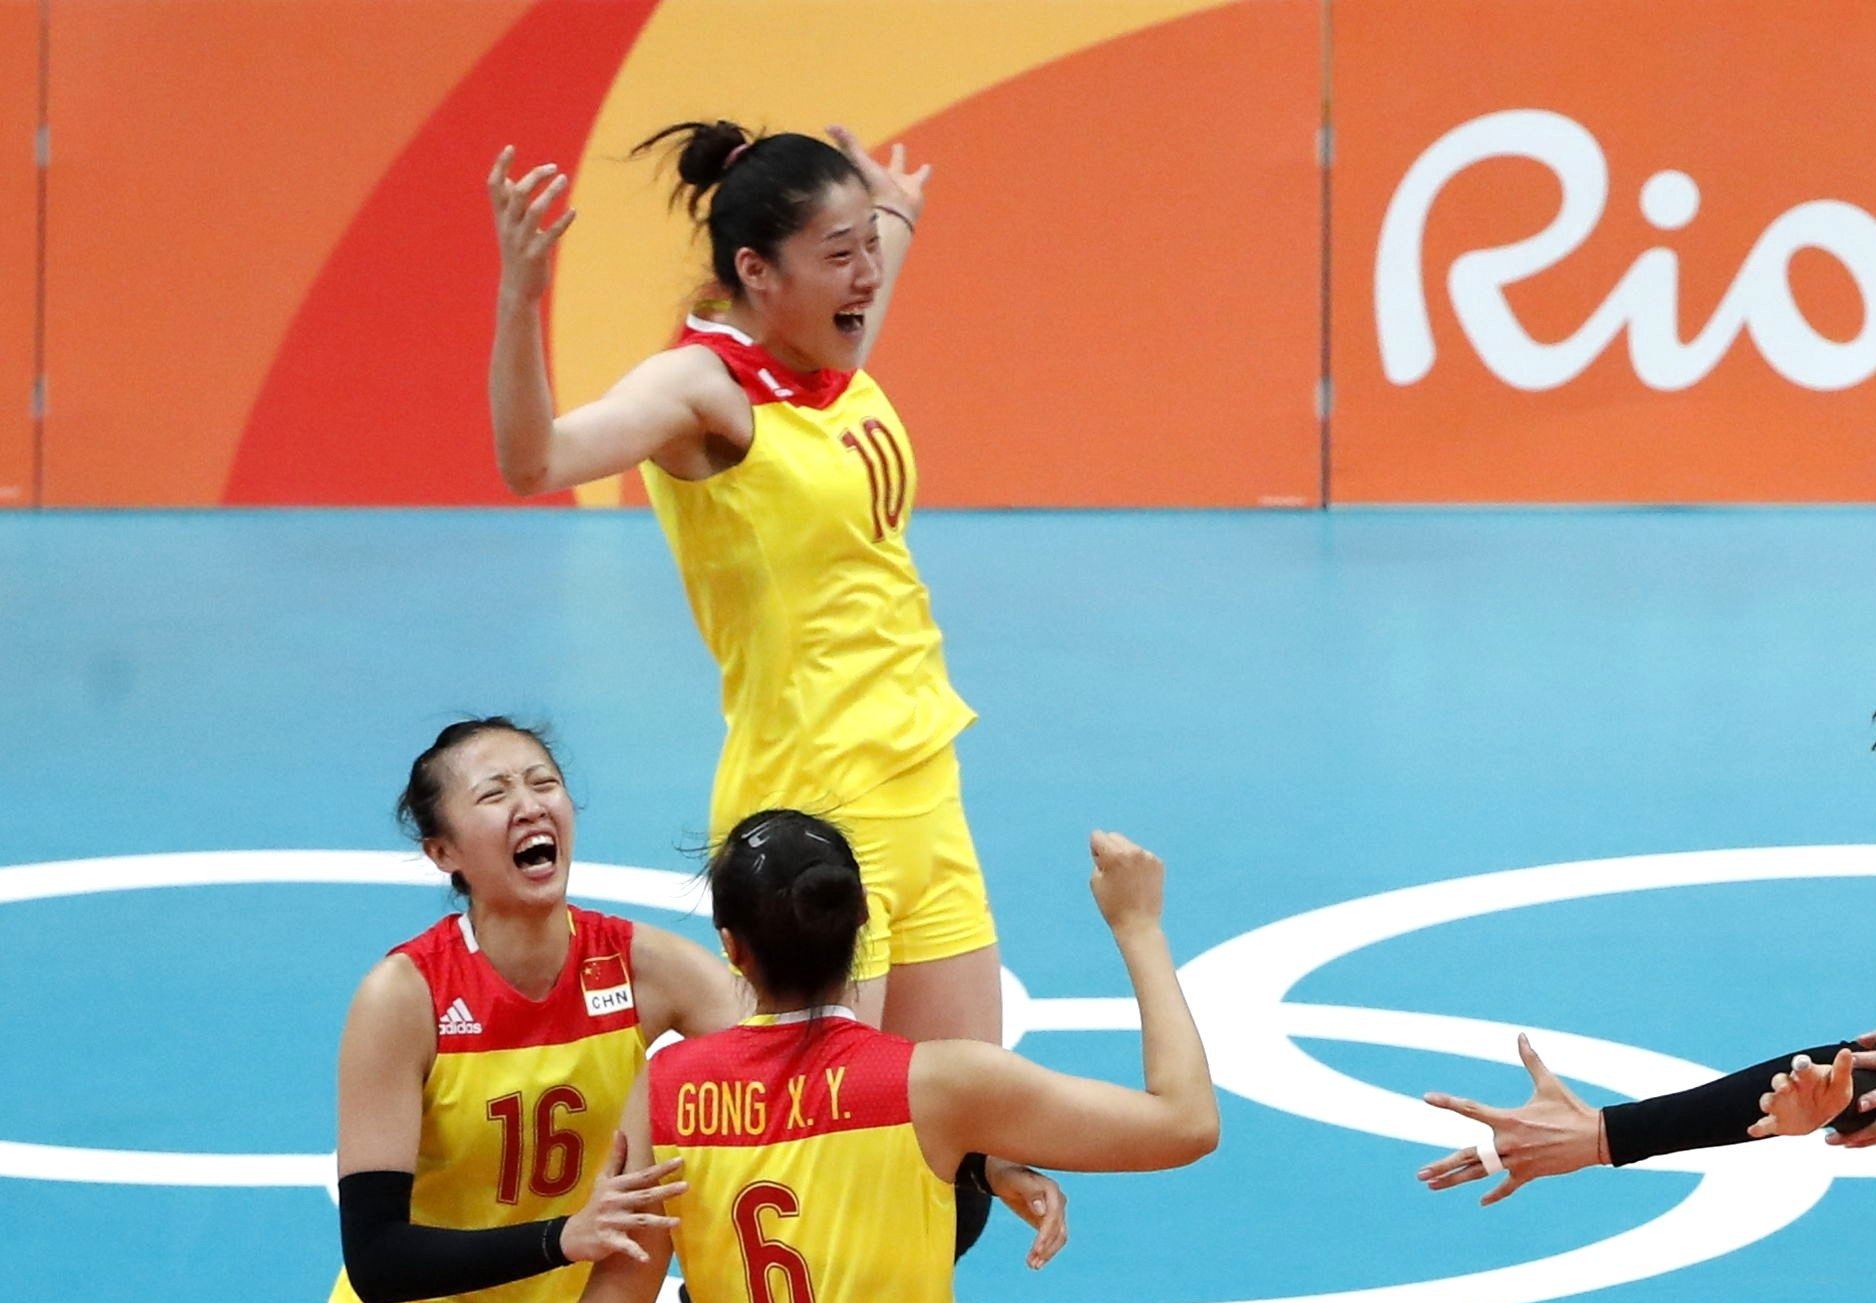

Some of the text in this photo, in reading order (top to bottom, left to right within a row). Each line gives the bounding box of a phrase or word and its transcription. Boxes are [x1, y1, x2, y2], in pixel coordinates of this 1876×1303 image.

[838, 415, 908, 541] 10
[591, 990, 629, 1010] CHN
[486, 1083, 588, 1207] 16
[676, 1065, 852, 1137] GONG X. Y.
